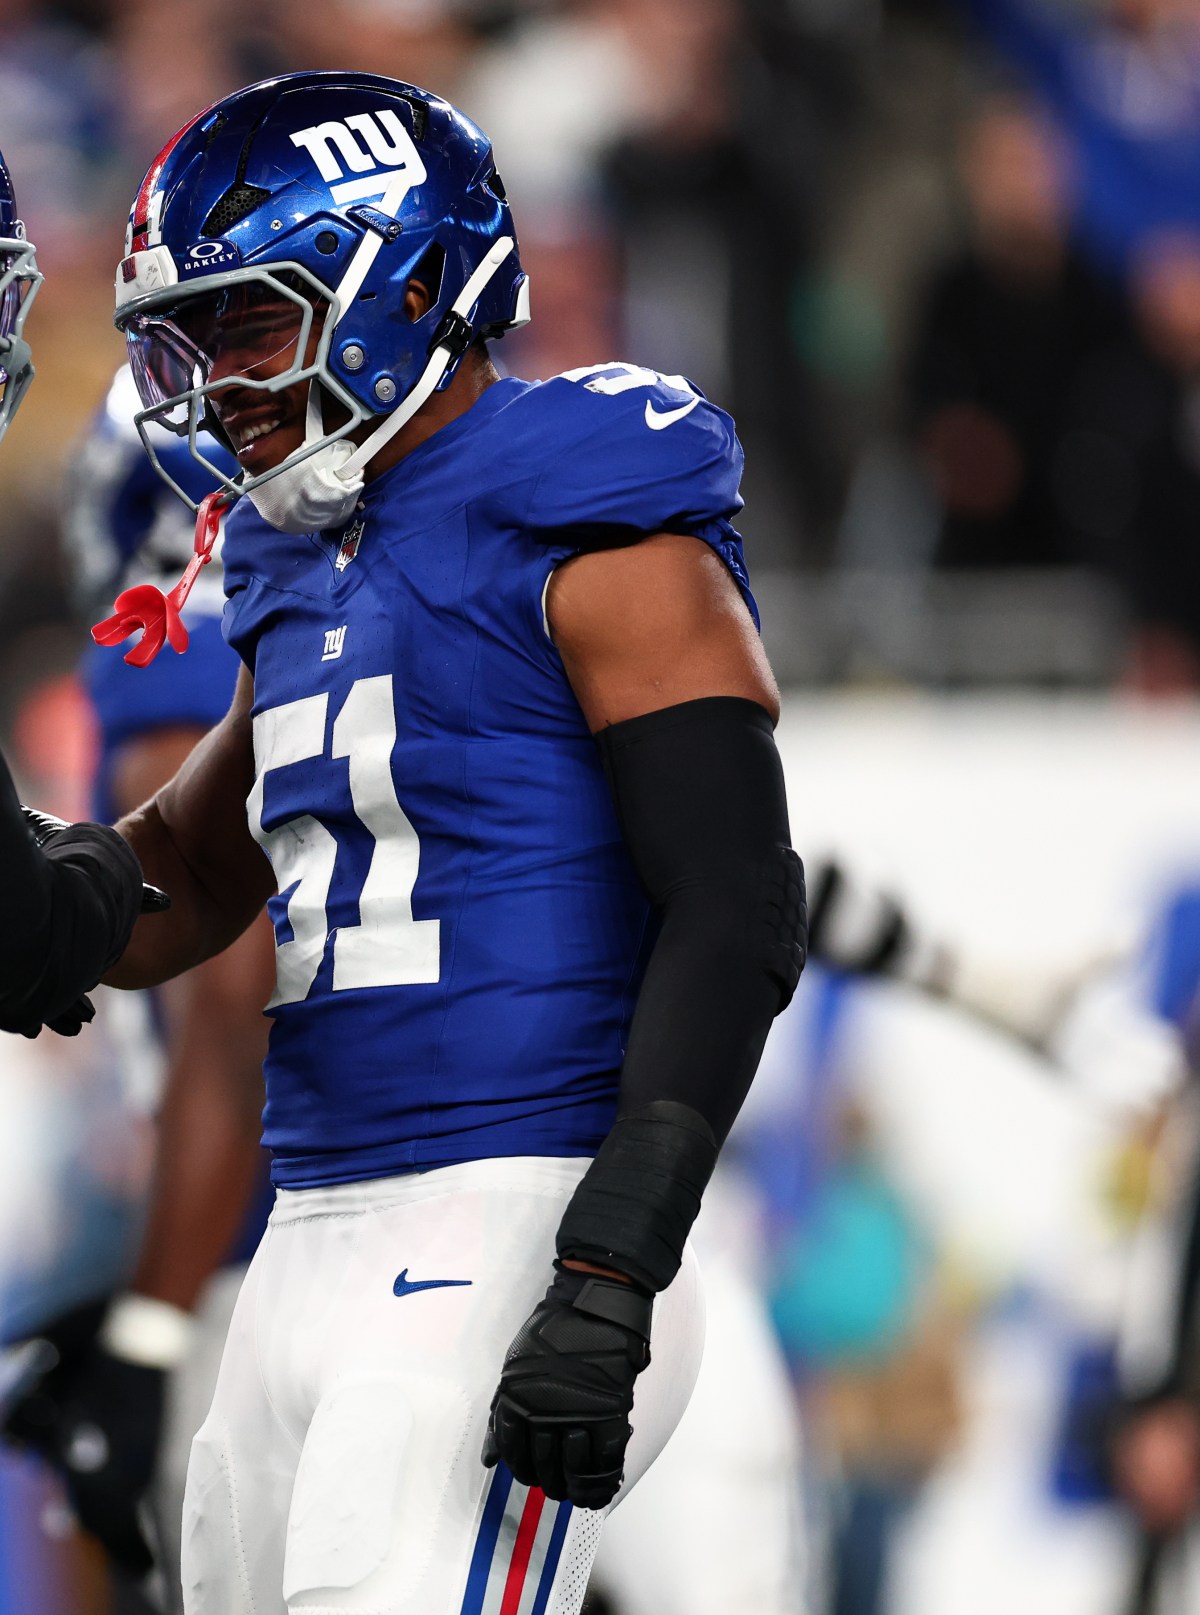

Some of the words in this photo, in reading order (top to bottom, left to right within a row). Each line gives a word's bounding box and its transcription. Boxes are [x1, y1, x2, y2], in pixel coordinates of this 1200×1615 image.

[289, 110, 427, 205] ny
[185, 253, 234, 270] OAKLEY
[321, 625, 347, 661] ny
[246, 674, 440, 1018] 51
